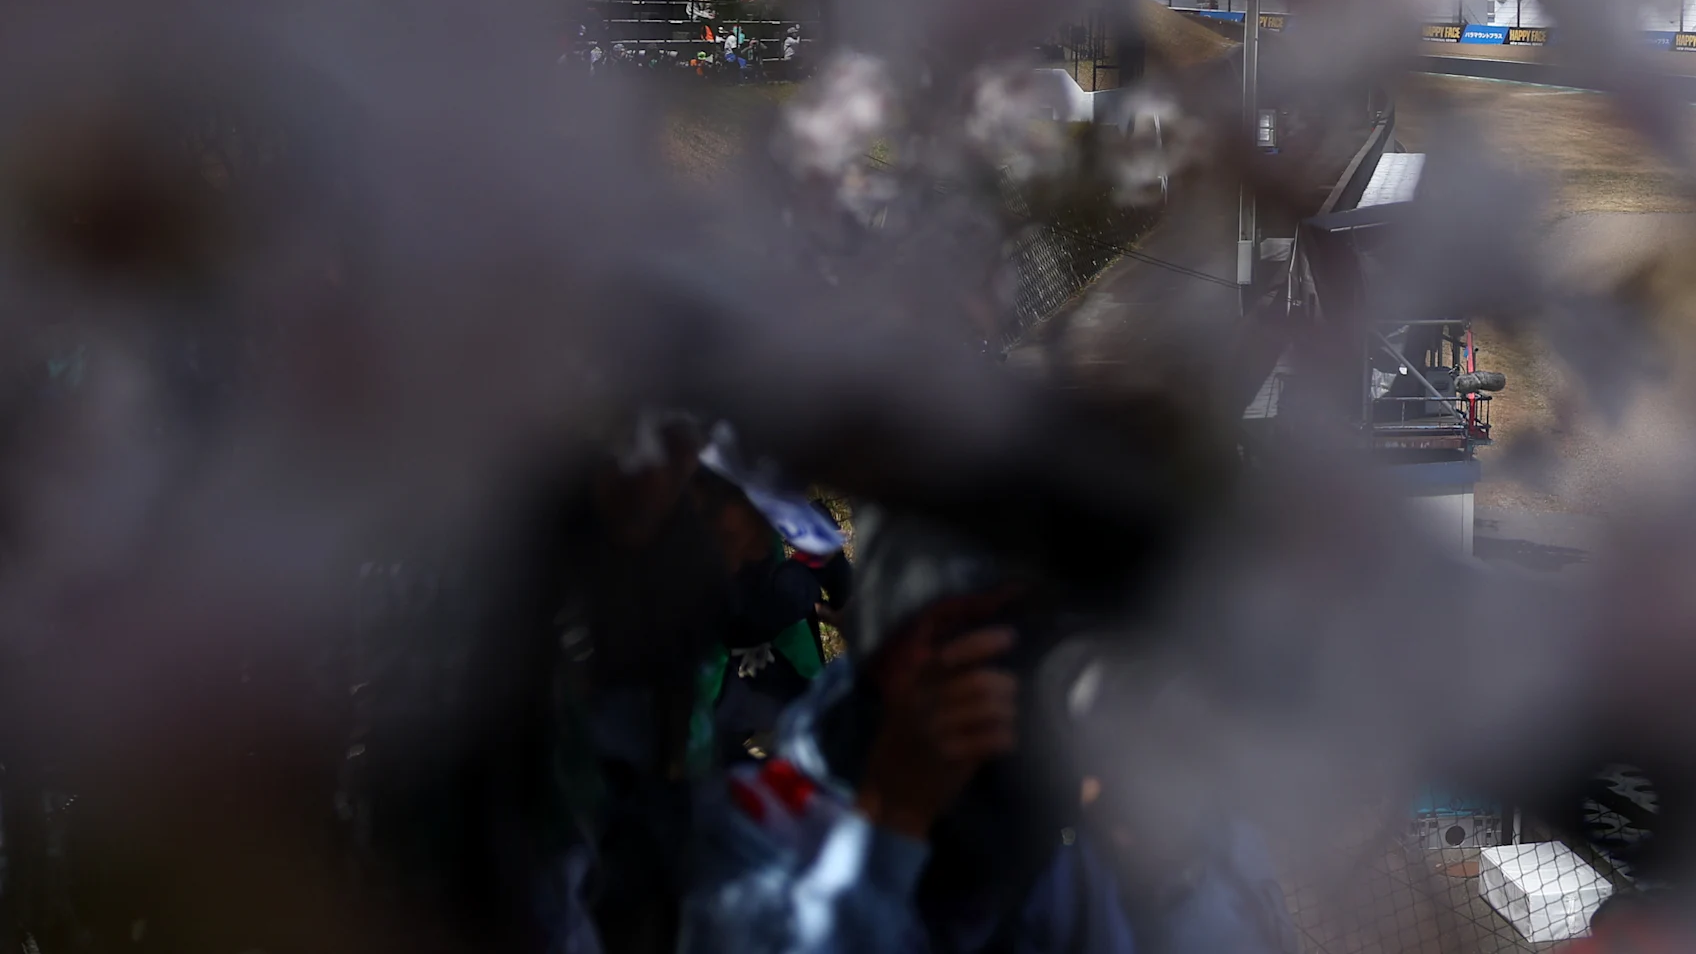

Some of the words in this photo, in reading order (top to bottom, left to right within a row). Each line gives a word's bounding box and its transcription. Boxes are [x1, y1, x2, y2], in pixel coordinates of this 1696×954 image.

[1445, 27, 1460, 39] FACE
[1510, 29, 1530, 42] HAPPY
[1531, 30, 1547, 43] FACE
[1676, 34, 1696, 47] HAPPY
